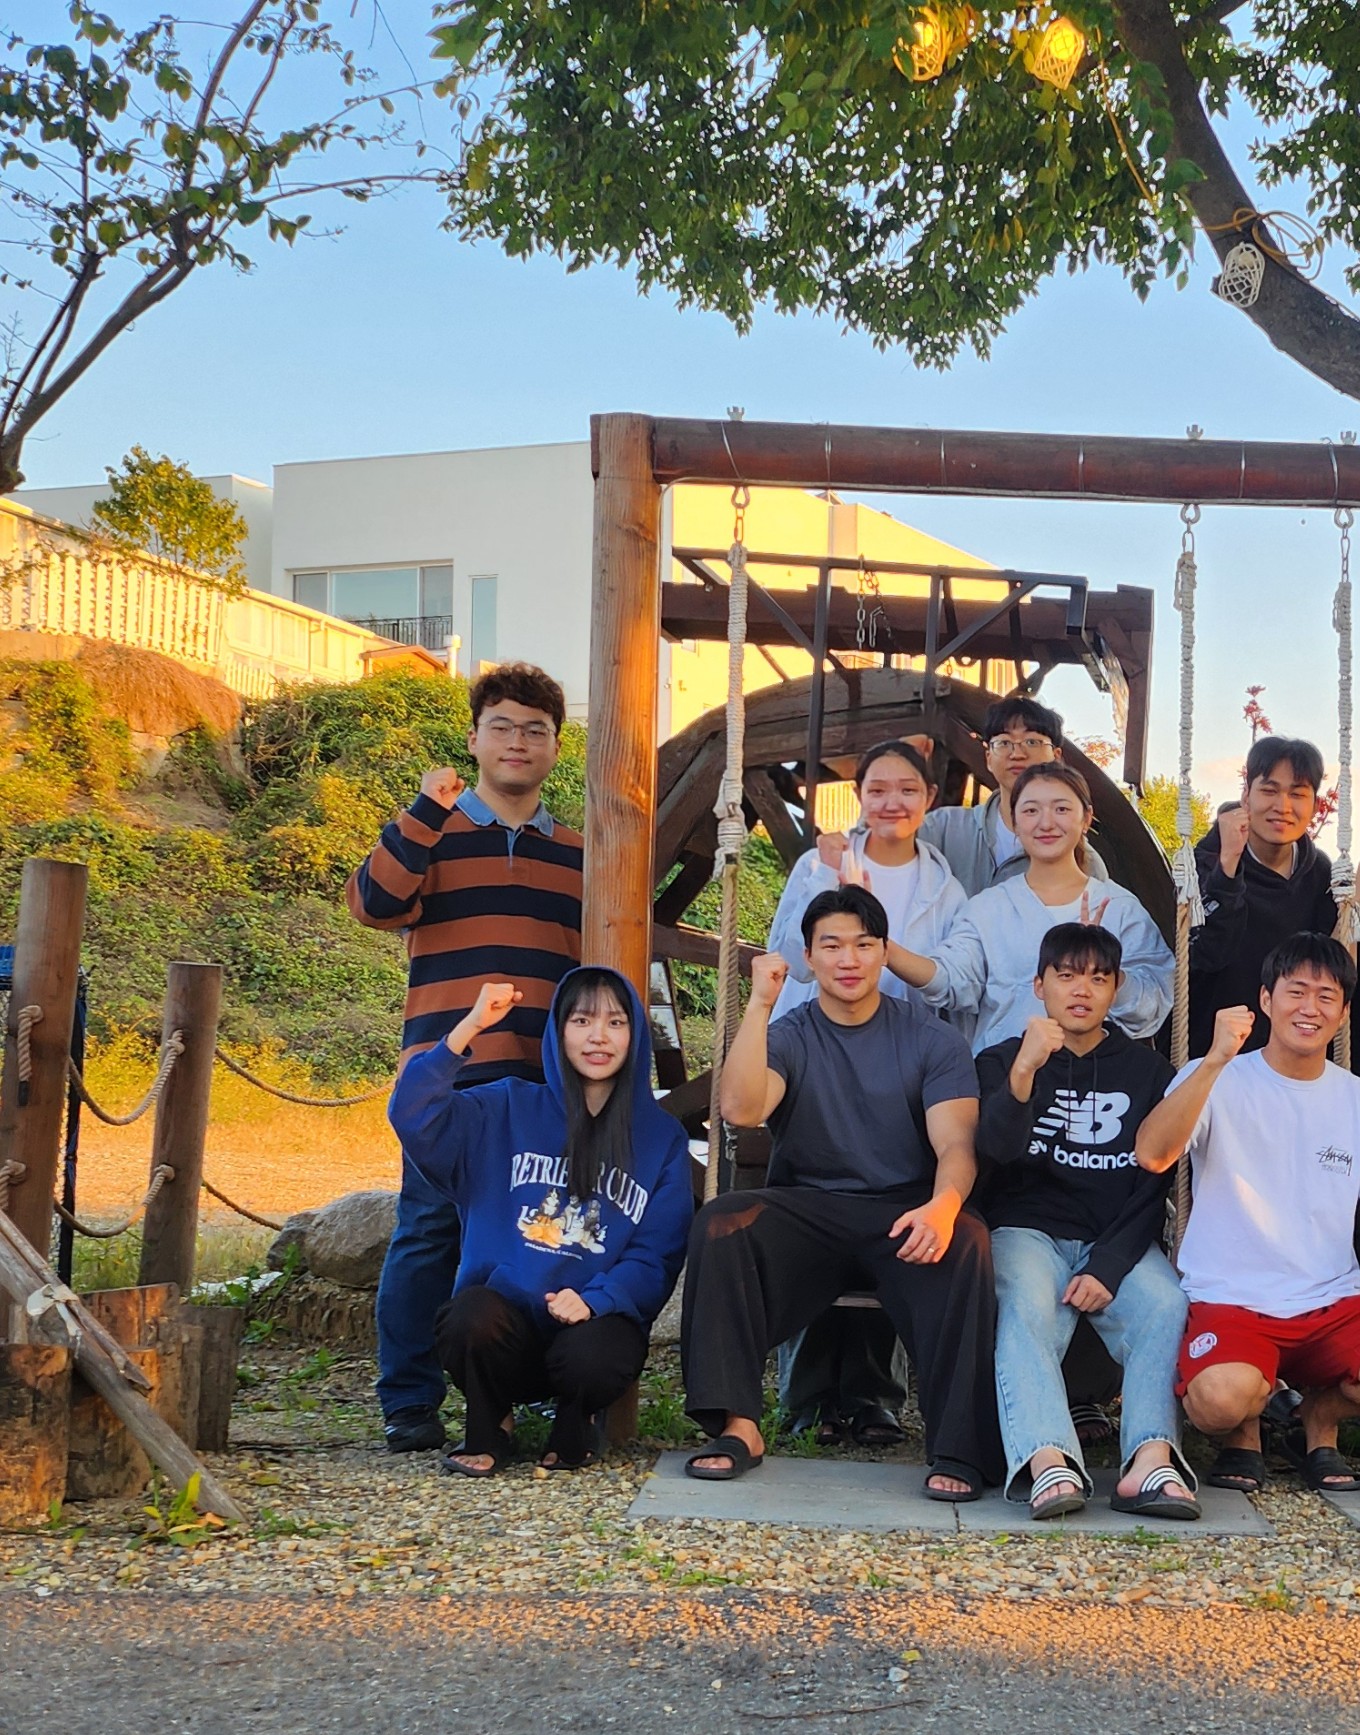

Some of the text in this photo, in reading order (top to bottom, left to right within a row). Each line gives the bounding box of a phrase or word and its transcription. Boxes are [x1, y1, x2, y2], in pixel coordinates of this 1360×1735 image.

[1053, 1145, 1138, 1169] balance
[510, 1152, 605, 1194] RETRIER
[606, 1167, 648, 1225] CLUB
